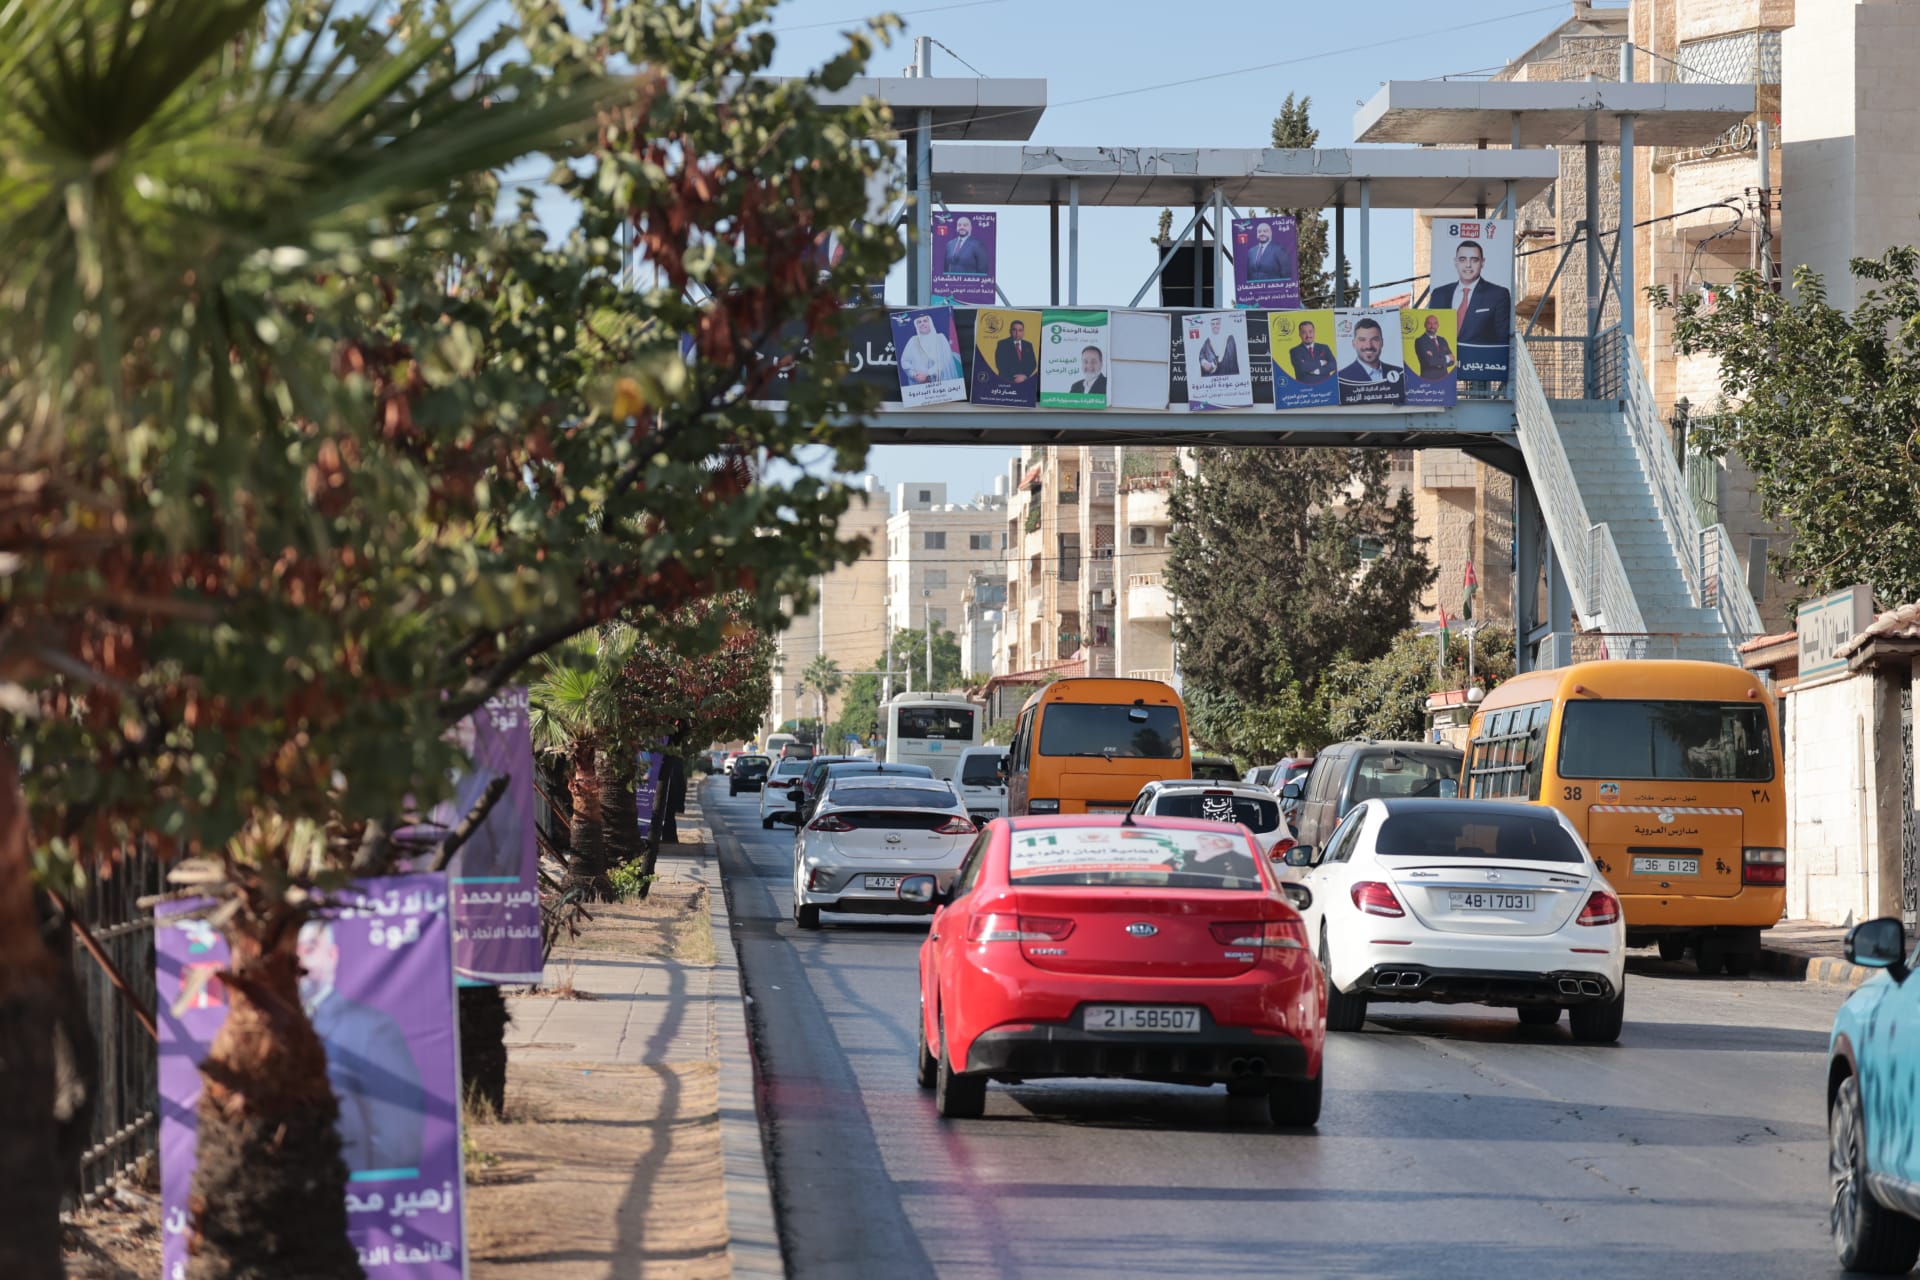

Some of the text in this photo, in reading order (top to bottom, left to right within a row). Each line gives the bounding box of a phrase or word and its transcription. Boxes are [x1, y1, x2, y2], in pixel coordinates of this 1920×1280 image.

[1449, 224, 1459, 236] 8
[1484, 363, 1507, 371] محمد
[490, 711, 518, 732] قوة
[1563, 786, 1582, 801] 38
[1751, 789, 1770, 804] ٣٨
[1667, 827, 1698, 836] مدارس
[460, 890, 502, 905] محمد
[504, 887, 540, 909] زهير
[368, 917, 420, 950] قوة
[471, 925, 506, 939] الاتحاد
[506, 925, 540, 939] قائمة
[1131, 925, 1154, 934] KIA
[389, 1181, 454, 1217] زهير
[393, 1240, 453, 1264] قائمة
